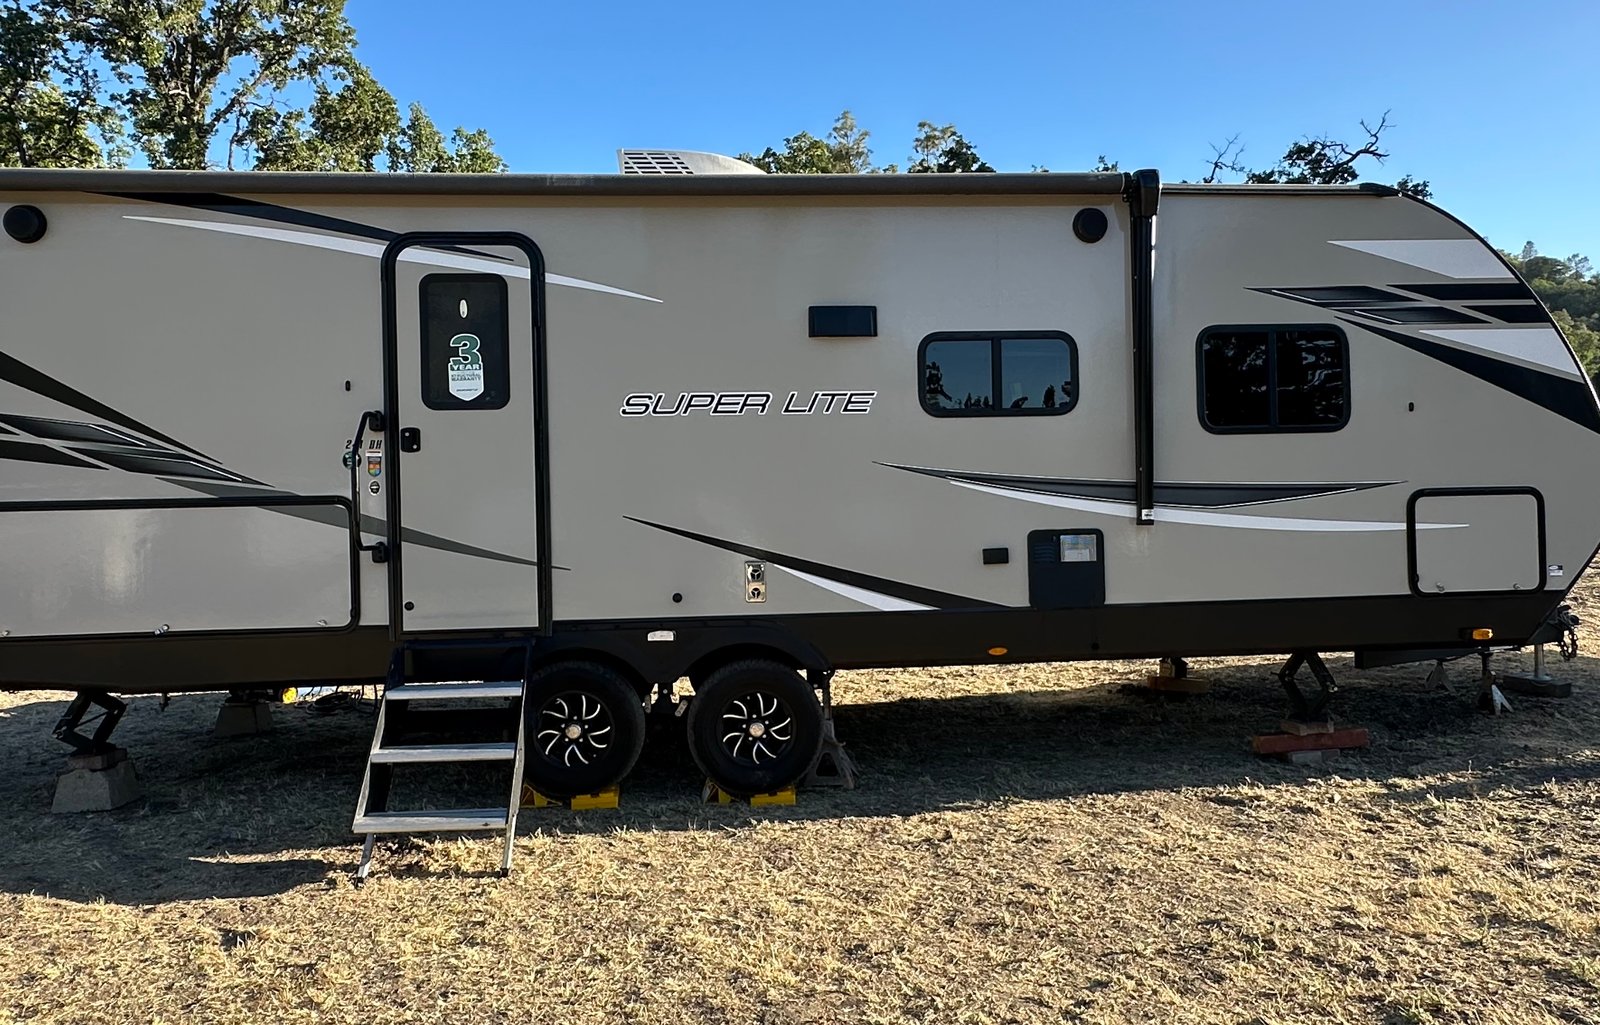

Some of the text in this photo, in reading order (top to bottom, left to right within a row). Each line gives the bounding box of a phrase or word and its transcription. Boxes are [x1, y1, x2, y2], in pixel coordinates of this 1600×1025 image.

[450, 333, 481, 364] 3
[620, 391, 877, 416] SUPER LITE
